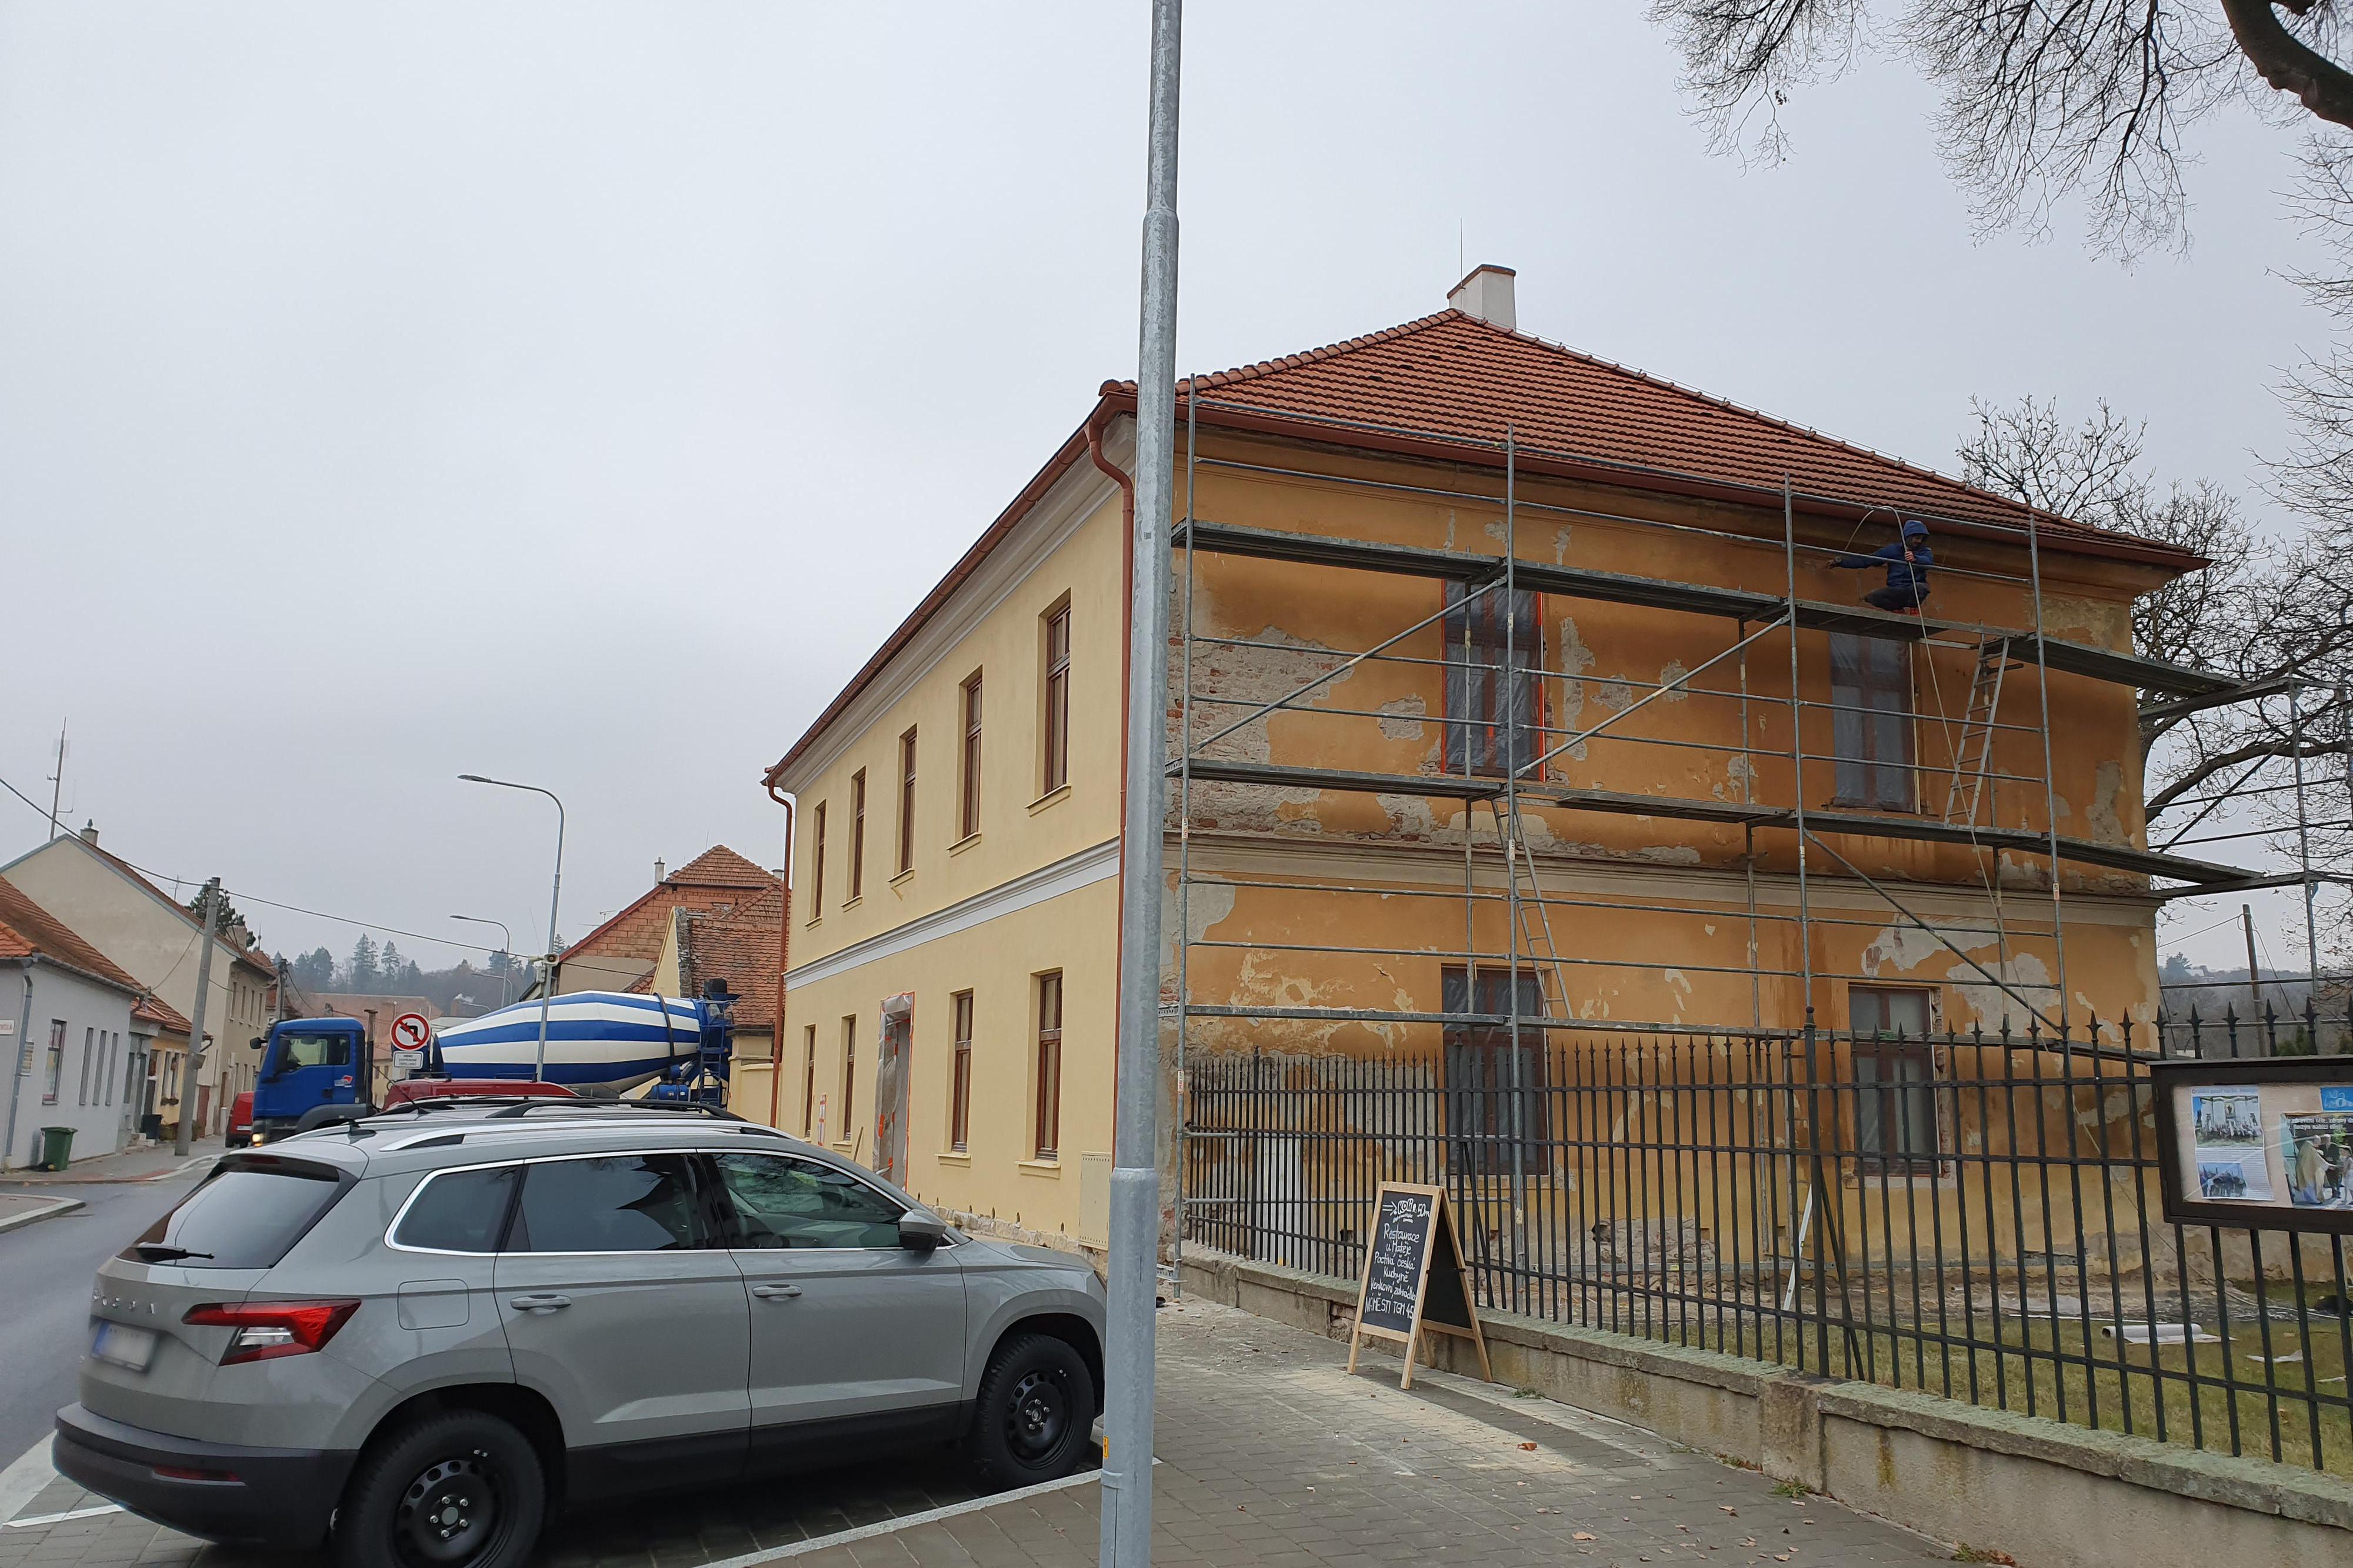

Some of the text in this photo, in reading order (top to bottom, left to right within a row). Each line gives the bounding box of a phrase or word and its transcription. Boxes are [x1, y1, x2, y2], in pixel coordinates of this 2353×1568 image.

[1383, 1223, 1419, 1243] Restaurace
[1392, 1240, 1411, 1256] Matěje
[1374, 1251, 1416, 1270] Poctivá česká
[1371, 1276, 1395, 1293] Venkovní
[1364, 1292, 1414, 1319] NÁMĚSTÍ TGM 45
